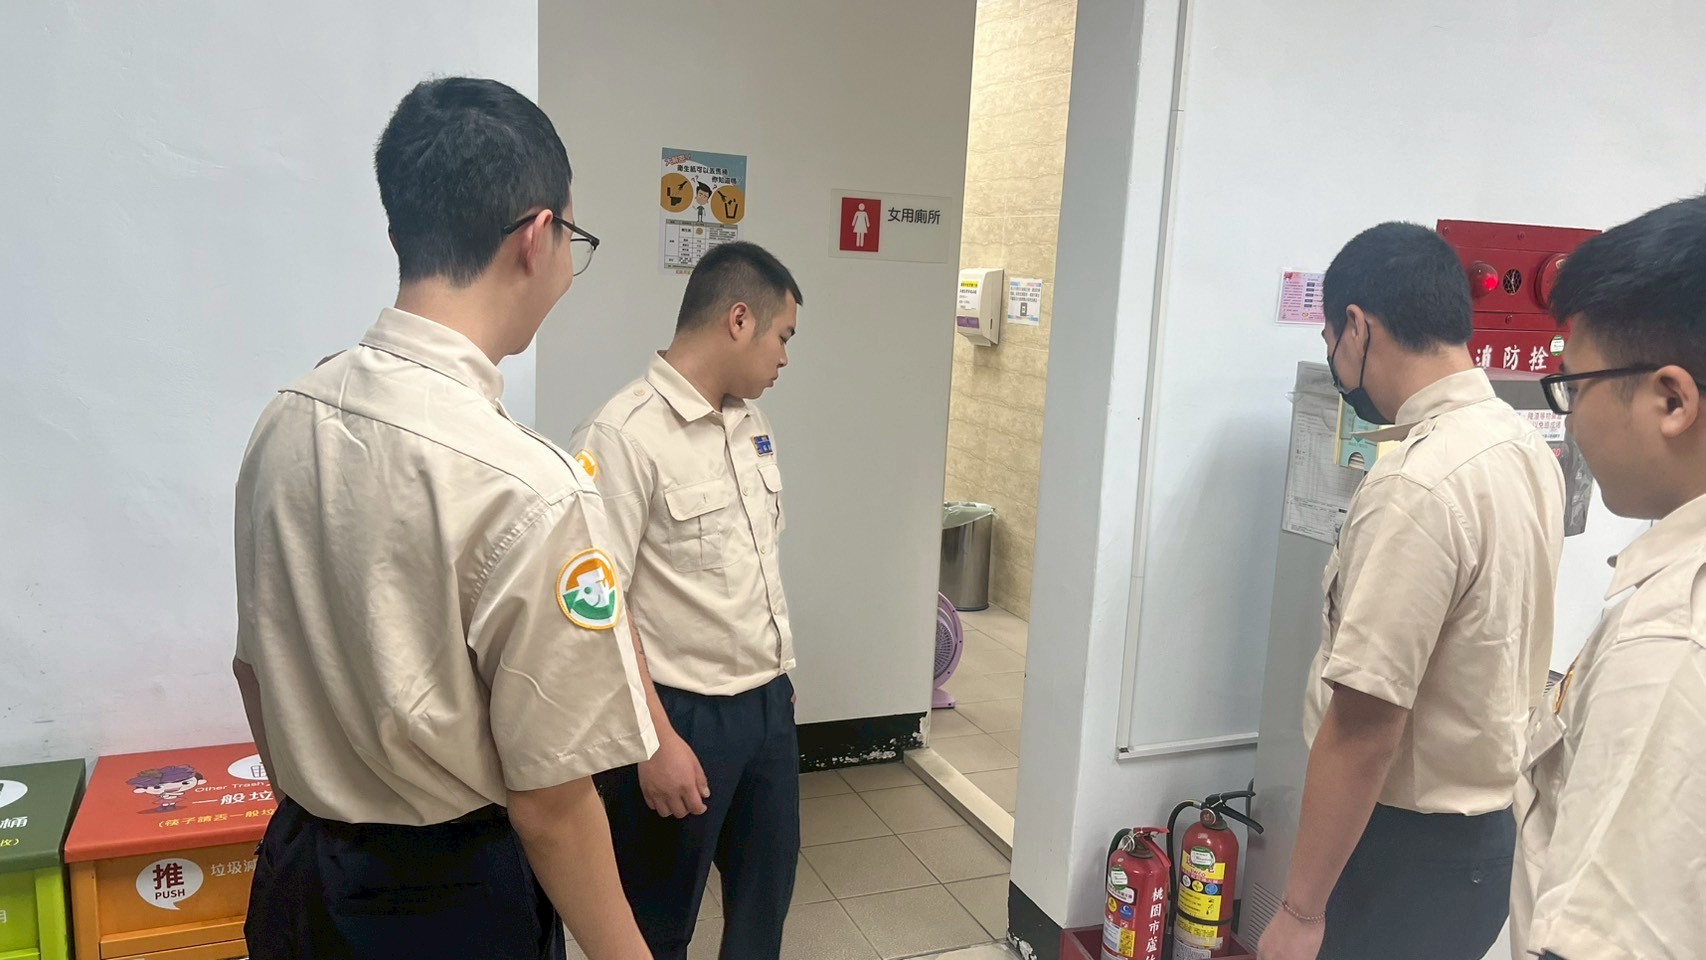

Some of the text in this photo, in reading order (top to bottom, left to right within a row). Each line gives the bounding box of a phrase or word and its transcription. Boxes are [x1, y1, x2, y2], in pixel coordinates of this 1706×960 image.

[888, 207, 941, 225] 女用廁所
[1475, 344, 1549, 371] 消防栓
[195, 781, 264, 793] Other Trash
[152, 862, 185, 890] 推
[154, 888, 186, 900] PUSH
